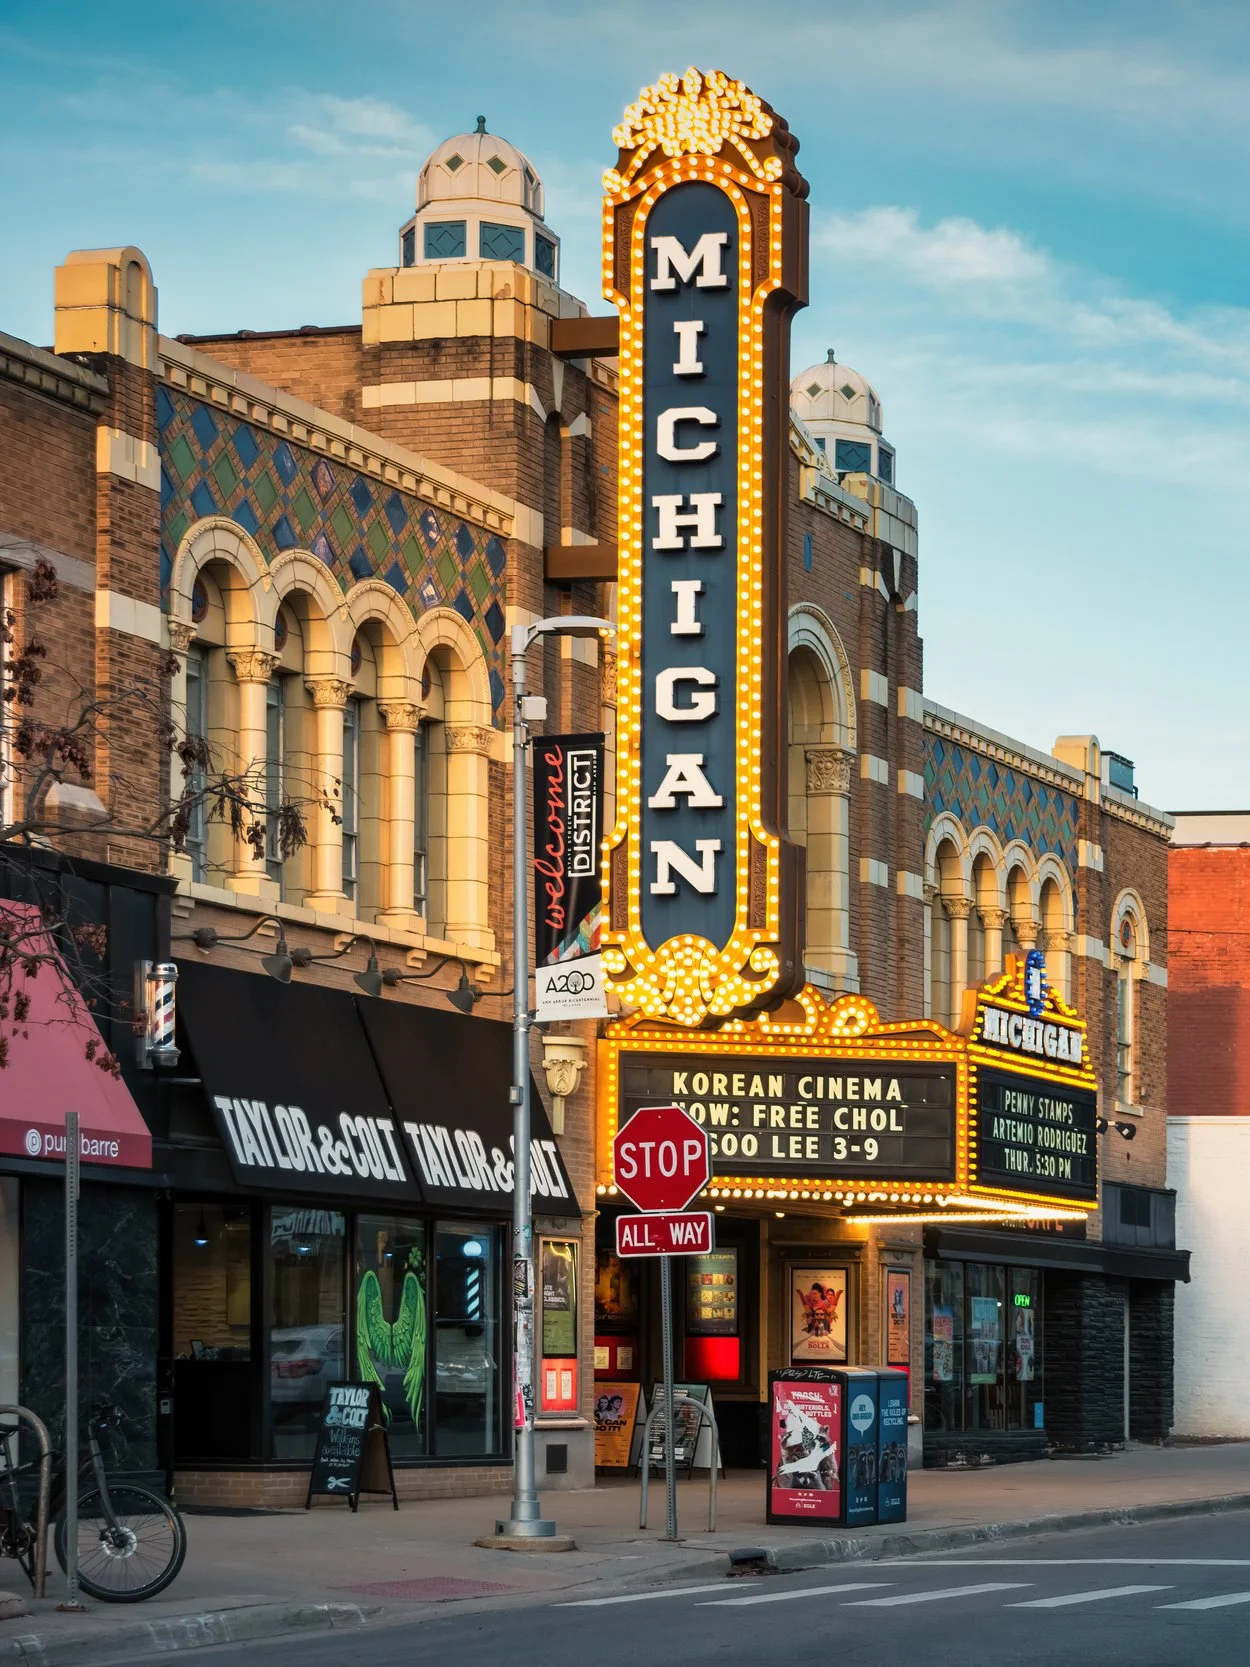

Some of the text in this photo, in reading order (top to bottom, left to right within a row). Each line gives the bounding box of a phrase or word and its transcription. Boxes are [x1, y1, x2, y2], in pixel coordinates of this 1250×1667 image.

[650, 232, 731, 895] MICHIGAN
[573, 756, 592, 870] DISTRICT
[534, 744, 566, 929] welcome
[983, 1006, 1083, 1065] MICHIGAN
[673, 1071, 902, 1101] KOREAN CINEMA
[753, 1104, 819, 1129] FREE
[834, 1107, 903, 1132] CHOL
[1005, 1089, 1073, 1125] PENNY STAMPS
[81, 1133, 119, 1158] barre
[772, 1135, 819, 1159] LEE
[833, 1137, 879, 1161] 3-9
[993, 1117, 1087, 1155] ARTEMIO RODRIGUEZ
[619, 1140, 702, 1179] STOP
[1005, 1148, 1072, 1180] THUR. 5:30 PM
[621, 1221, 705, 1247] ALL WAY
[1014, 1294, 1031, 1307] OPEN
[330, 1387, 369, 1407] TAYLOR
